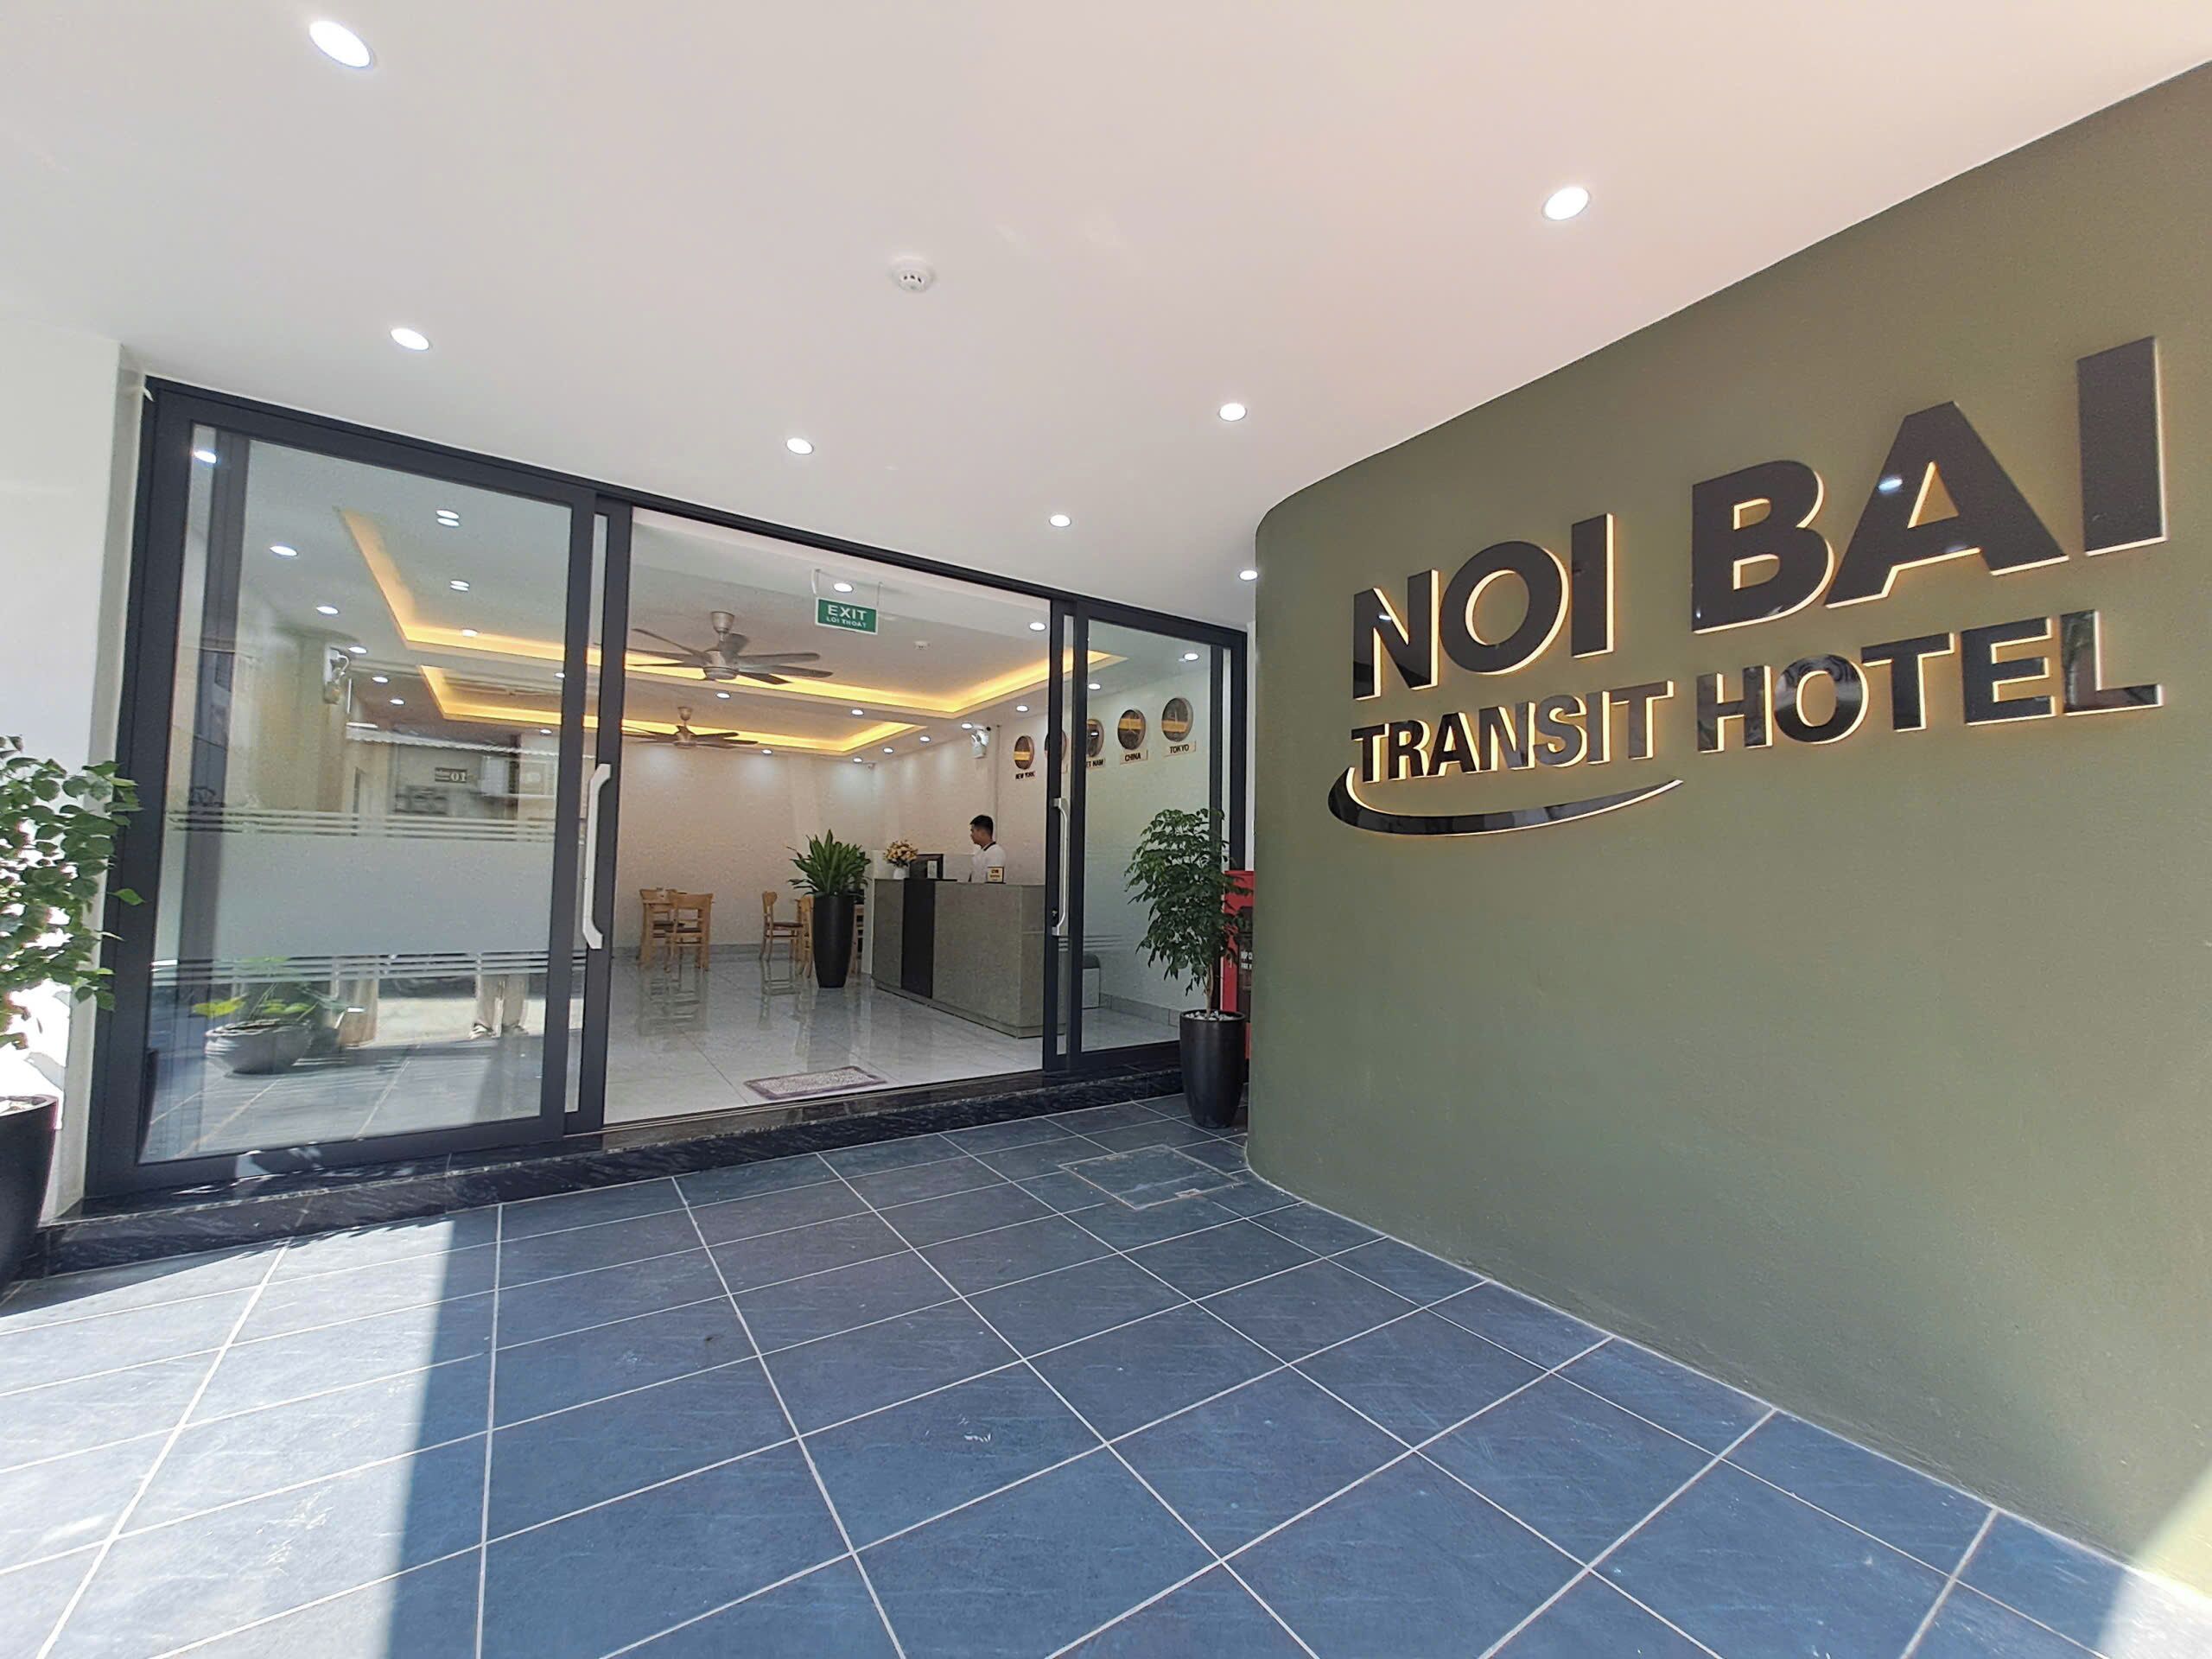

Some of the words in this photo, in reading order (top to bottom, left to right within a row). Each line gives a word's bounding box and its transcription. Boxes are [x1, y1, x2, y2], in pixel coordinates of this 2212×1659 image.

[1353, 513, 1615, 701] NOI
[1692, 336, 2169, 634] BAI
[828, 604, 868, 621] EXIT
[1351, 681, 1675, 784] TRANSIT
[1696, 609, 2164, 753] HOTEL
[1124, 753, 1141, 761] CHINA
[1170, 744, 1190, 753] TOKYO
